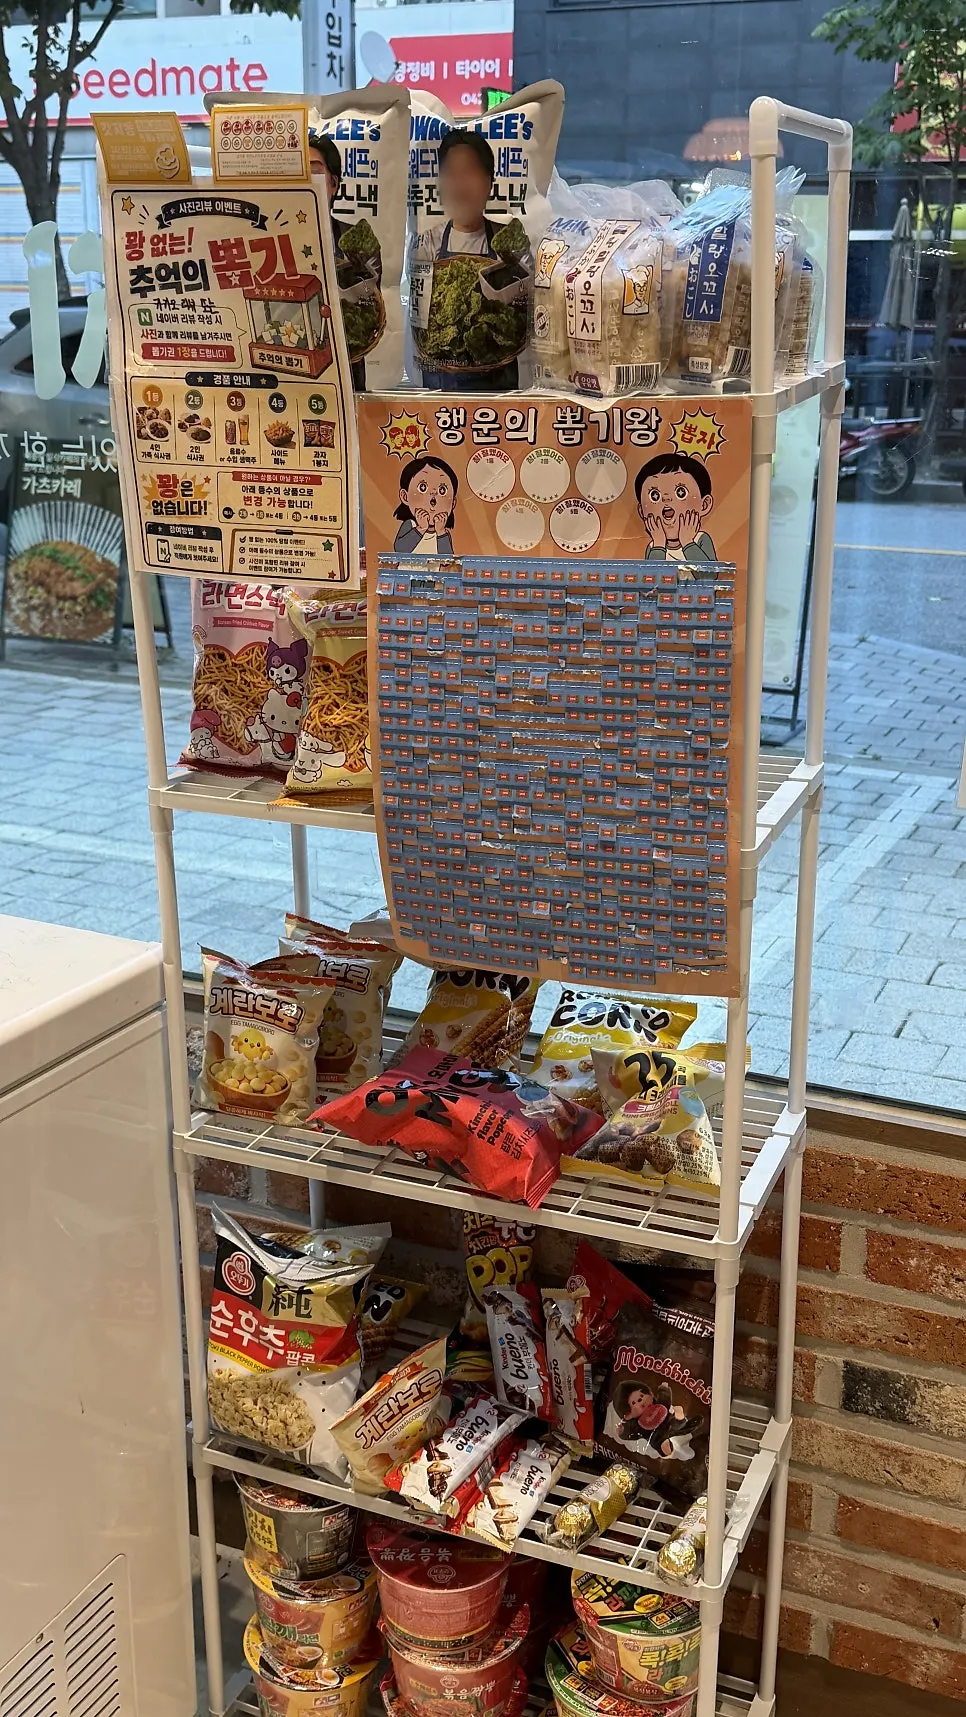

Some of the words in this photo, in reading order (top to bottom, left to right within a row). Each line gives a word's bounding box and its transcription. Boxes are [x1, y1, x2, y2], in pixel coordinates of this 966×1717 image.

[326, 0, 345, 88] 입차
[455, 58, 501, 79] 타이어
[60, 57, 268, 99] eedmate
[179, 200, 212, 214] 사진리뷰
[215, 200, 241, 214] 이벤트
[125, 230, 146, 262] 꽝
[150, 226, 195, 258] 없는!
[129, 258, 211, 299] 추억의
[208, 234, 300, 291] 뽑기
[156, 313, 180, 325] 네이버
[181, 314, 196, 325] 리뷰
[197, 314, 213, 326] 작성
[215, 315, 223, 326] 시
[141, 329, 164, 340] 사진과
[180, 331, 199, 341] 리뷰를
[200, 332, 233, 342] 남겨주시면
[152, 346, 175, 358] 뽑기권
[177, 347, 198, 358] 1장을
[258, 351, 283, 366] 추억의
[285, 354, 304, 369] 뽑기
[213, 374, 231, 386] 경품
[233, 375, 251, 387] 안내
[146, 390, 160, 402] 1등
[187, 395, 201, 405] 2등
[229, 396, 243, 407] 3등
[270, 397, 284, 408] 4등
[311, 399, 324, 410] 5등
[435, 406, 539, 445] 행운의
[553, 405, 663, 446] 뽑기왕
[680, 421, 716, 450] 뽑자
[150, 443, 161, 452] 4인
[189, 445, 201, 454] 2인
[270, 449, 289, 457] 사이드
[313, 450, 327, 459] 과자
[154, 452, 171, 461] 식사권
[186, 453, 205, 462] 식사권
[156, 474, 194, 498] 꽝은
[241, 485, 256, 494] 아래
[258, 486, 281, 495] 등수의
[282, 487, 314, 497] 상품으로
[151, 500, 208, 516] 없습니다!
[243, 495, 263, 507] 변경
[317, 959, 373, 995] 보로
[209, 986, 304, 1036] 계란보로
[476, 1108, 499, 1140] flavor
[230, 1272, 249, 1289] 오뚜기
[210, 1299, 285, 1361] 순후추
[219, 1347, 237, 1359] BLACK
[286, 1350, 316, 1366] 팝콘
[504, 1332, 529, 1381] bueno
[613, 1345, 713, 1405] Monchhichi
[355, 1368, 444, 1450] 계란보로
[456, 1415, 490, 1452] bueno
[520, 1464, 544, 1496] bueno
